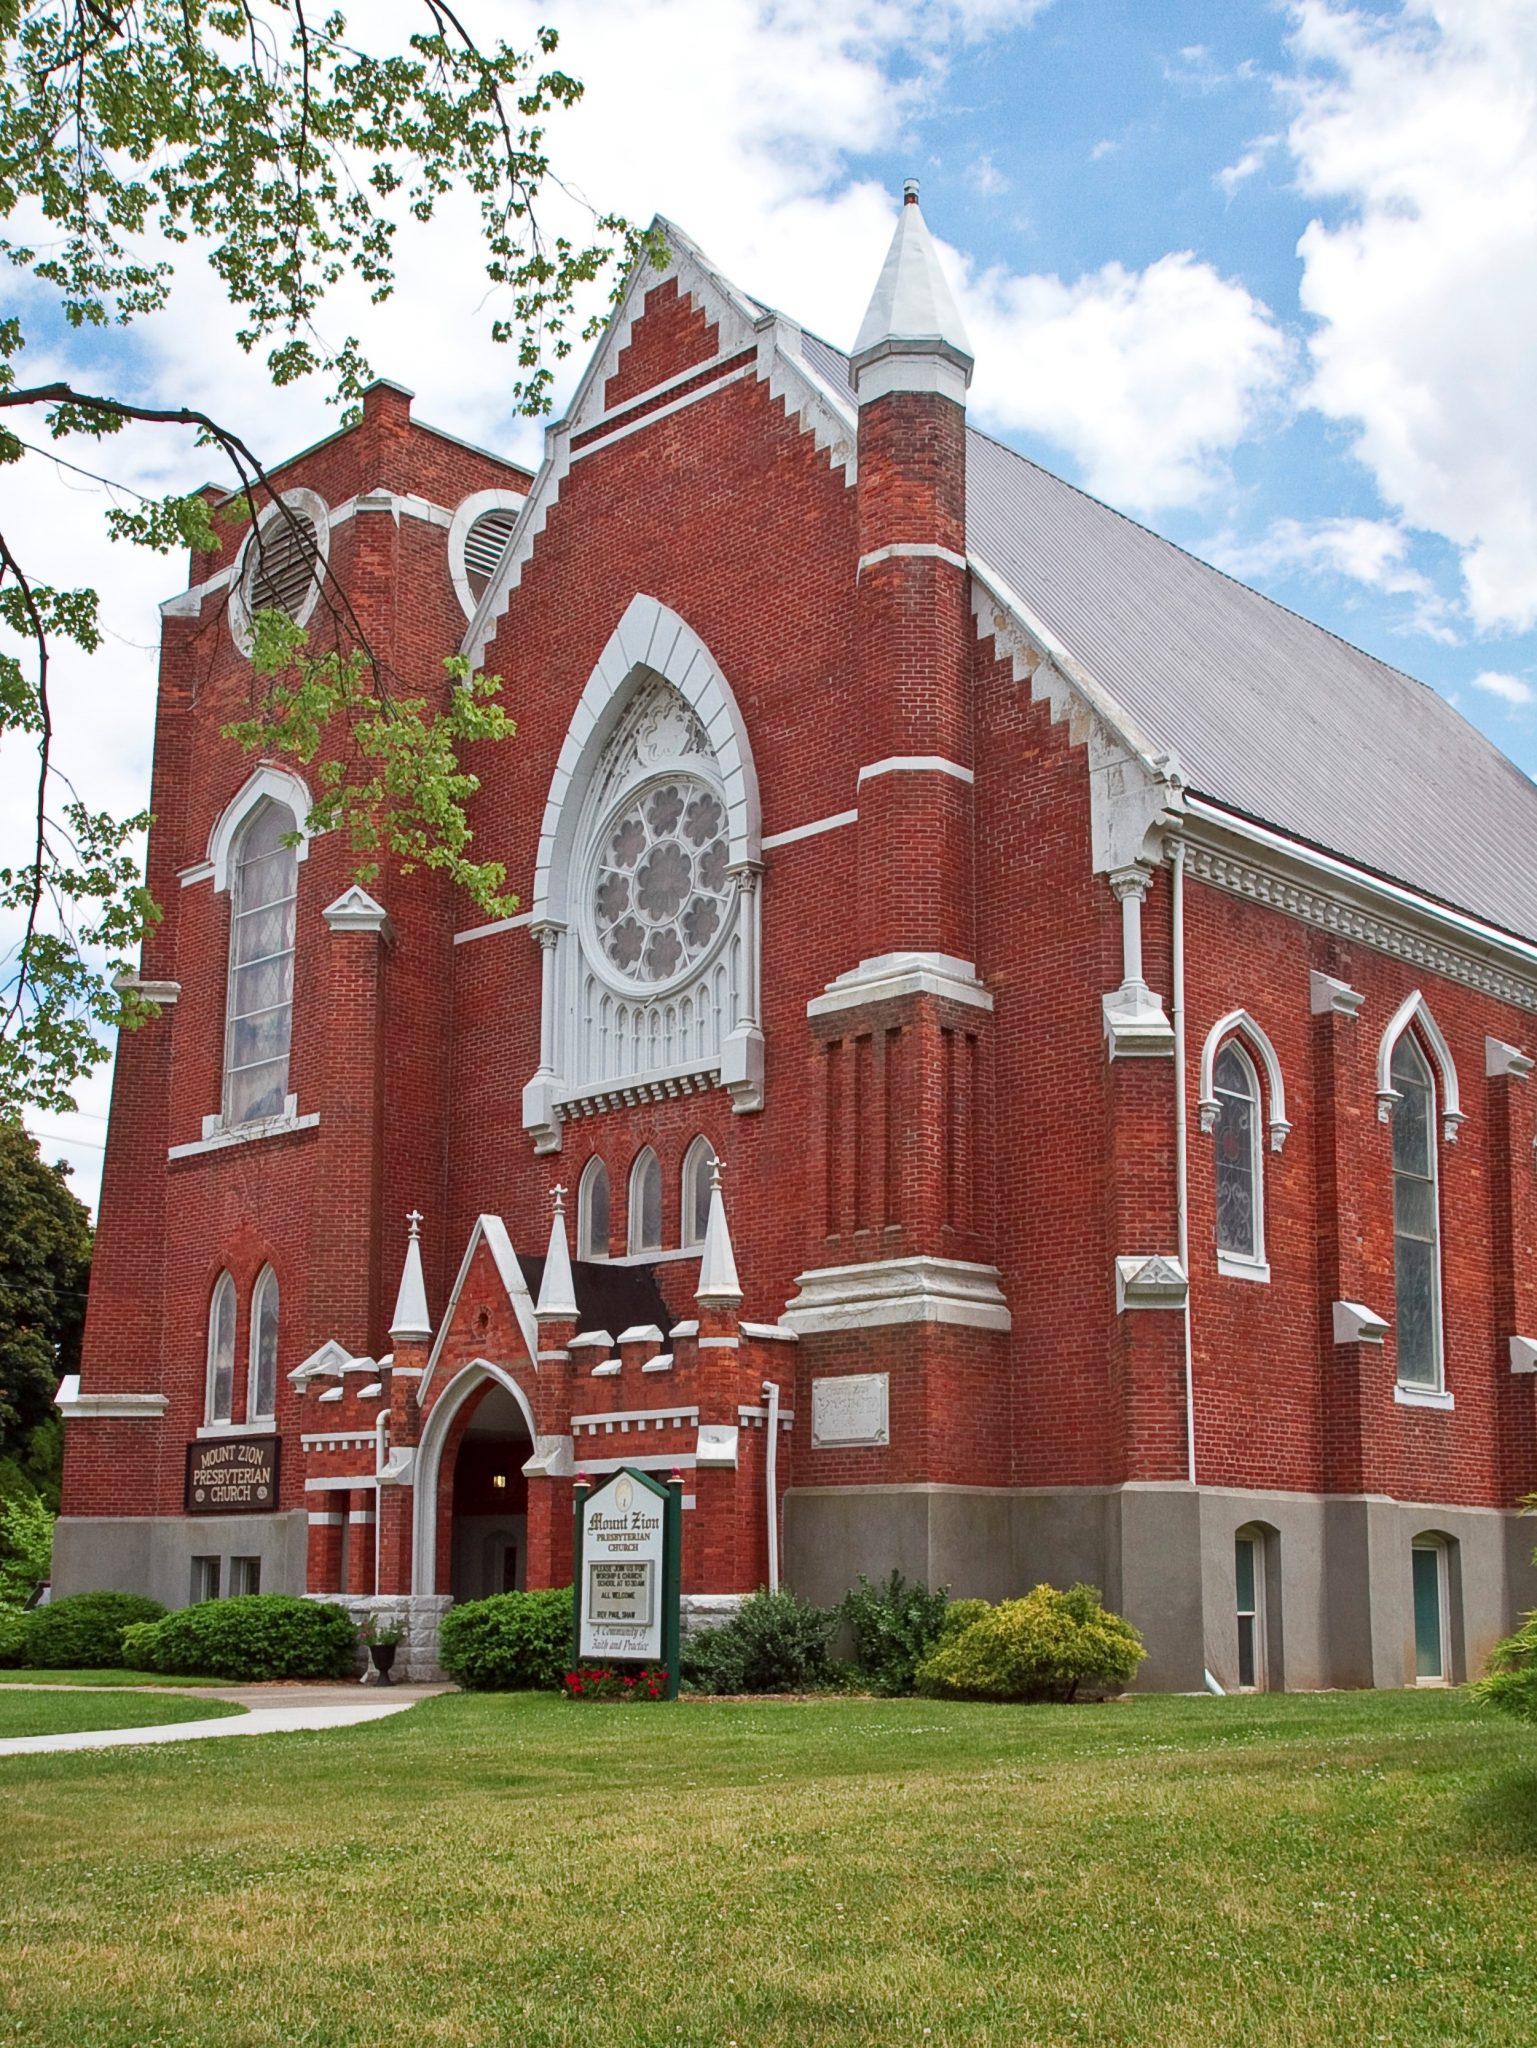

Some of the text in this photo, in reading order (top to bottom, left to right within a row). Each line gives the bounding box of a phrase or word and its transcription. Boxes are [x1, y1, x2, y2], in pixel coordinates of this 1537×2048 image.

[201, 1445, 264, 1469] MOUNT ZION
[193, 1467, 271, 1485] PRESBYTERIAN
[210, 1485, 251, 1502] CHURCH
[587, 1511, 659, 1536] Mount Zion
[596, 1533, 651, 1542] PRESBYTERIAN
[608, 1543, 639, 1552] CHURCH
[612, 1591, 636, 1599] WELCOME
[593, 1625, 647, 1639] A Community of
[592, 1638, 649, 1651] Faith and Practice
